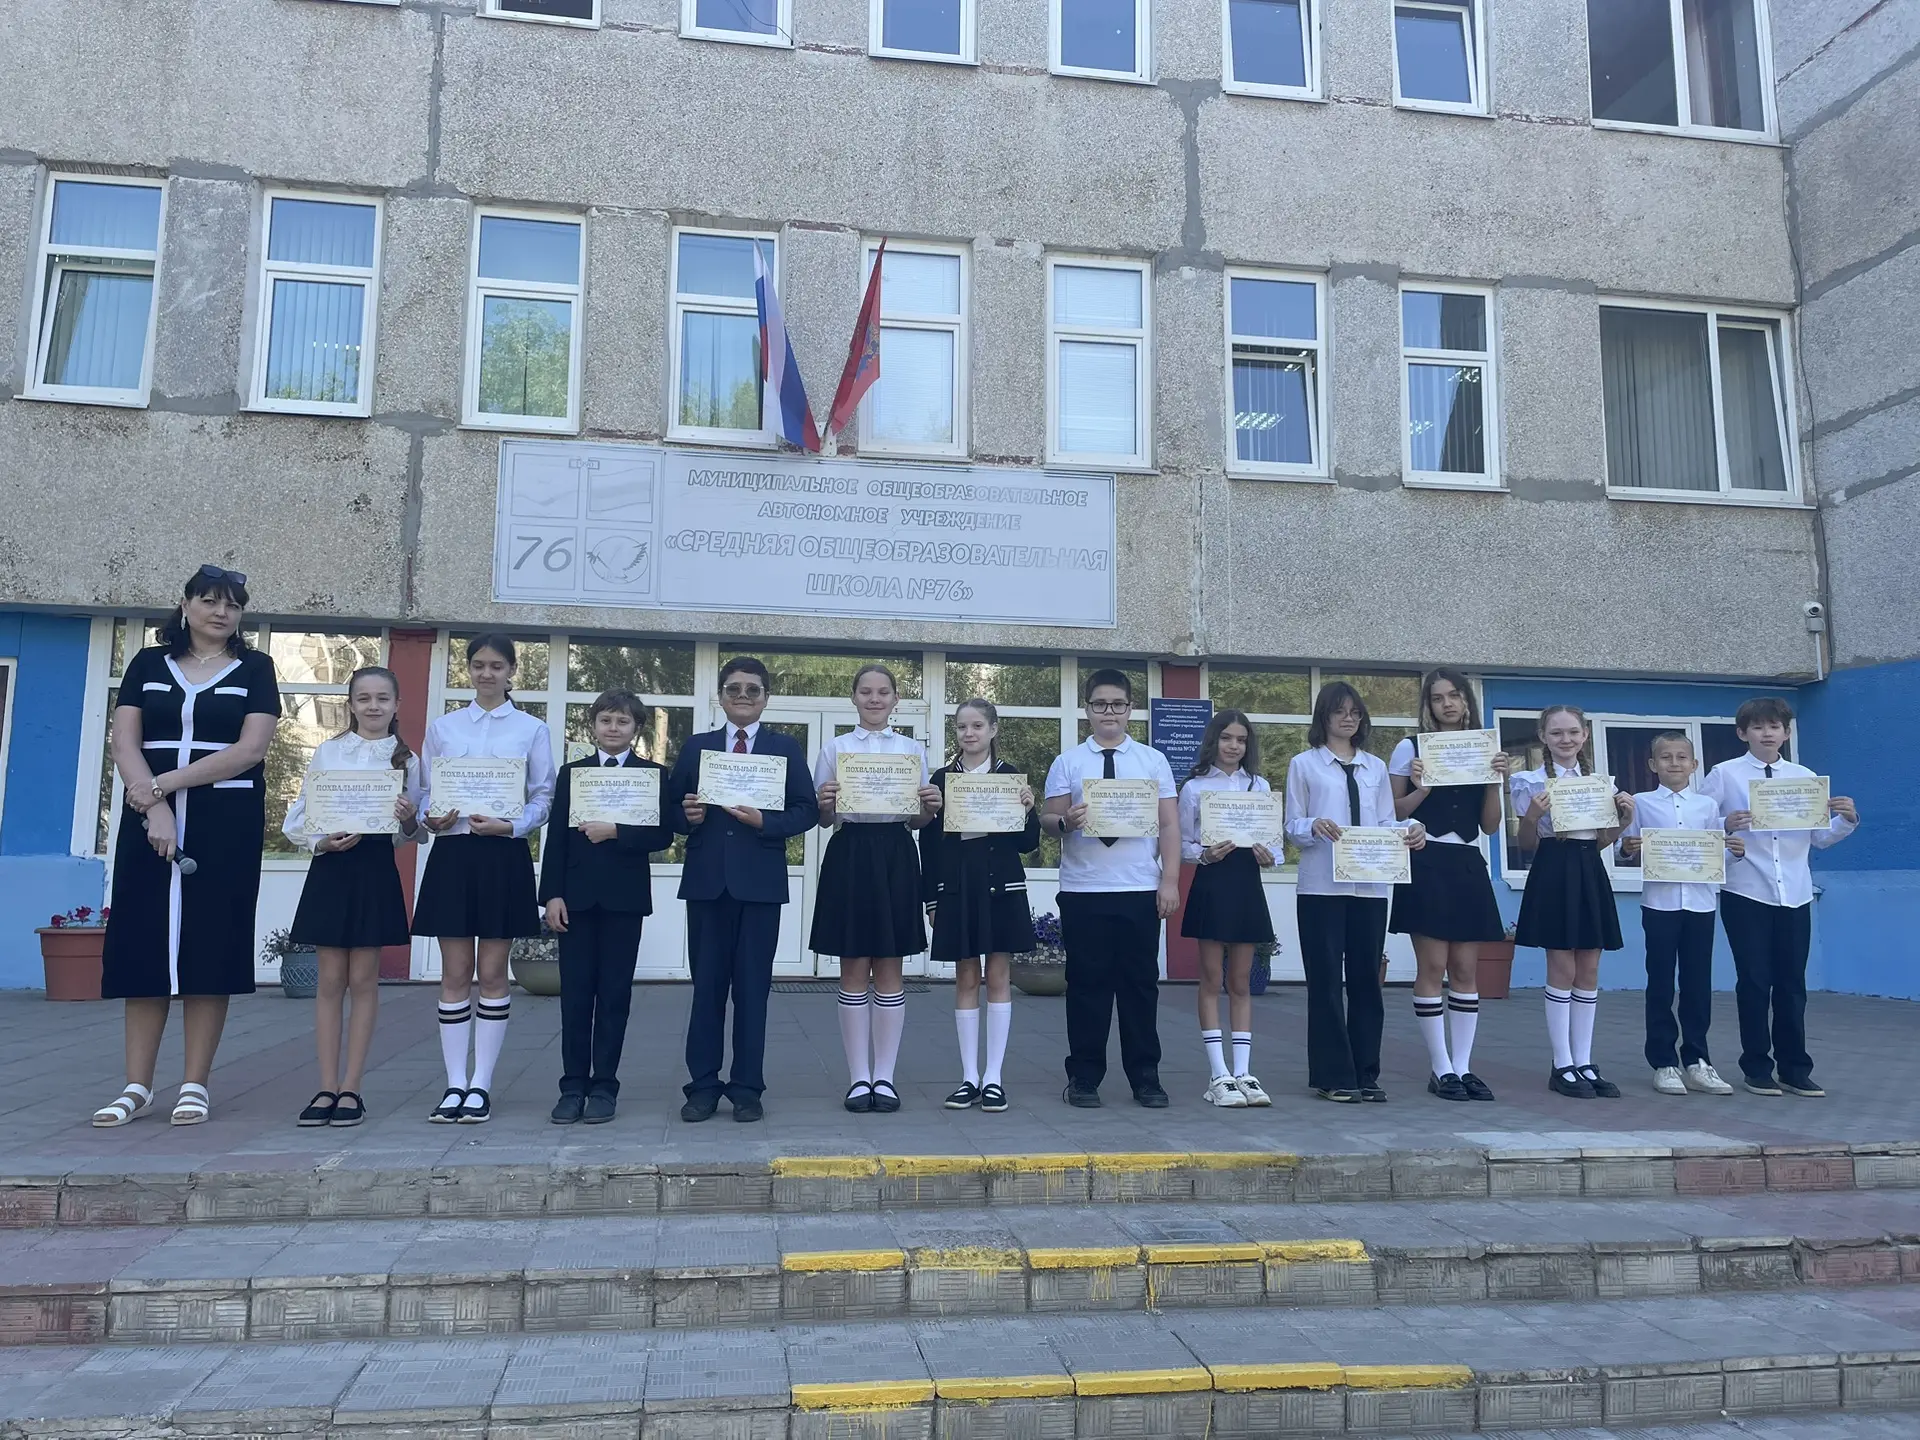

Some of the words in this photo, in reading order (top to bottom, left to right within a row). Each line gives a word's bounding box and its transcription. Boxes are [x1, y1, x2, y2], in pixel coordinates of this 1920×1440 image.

[688, 469, 858, 495] МУНИЦИПАЛЬНОЕ
[867, 479, 1088, 506] ОБЩЕОБРАЗОВАТЕЛЬНОЕ
[757, 501, 888, 523] АВТОНОМНОЕ
[901, 509, 1021, 531] УЧРЕЖДЕНИЕ
[664, 529, 795, 557] «СРЕДНЯЯ
[798, 535, 1108, 570] ОБЩЕОБРАЗОВАТЕЛЬНАЯ
[513, 536, 574, 572] 76
[806, 573, 902, 600] ШКОЛА
[907, 577, 973, 601] №76»
[708, 762, 757, 773] ПОХВАЛЬНЫЙ
[759, 766, 778, 774] ЛИСТ
[846, 766, 893, 774] ПОХВАЛЬНЫЙ
[440, 770, 494, 778] ПОХВАЛЬНЫЙ
[316, 784, 371, 792] ПОХВАЛЬНЫЙ
[580, 780, 630, 788] ПОХВАЛЬНЫЙ
[953, 786, 999, 794] ПОХВАЛЬНЫЙ
[1090, 790, 1134, 798] ПОХВАЛЬНЫЙ
[1209, 802, 1254, 810] ПОХВАЛЬНЫЙ
